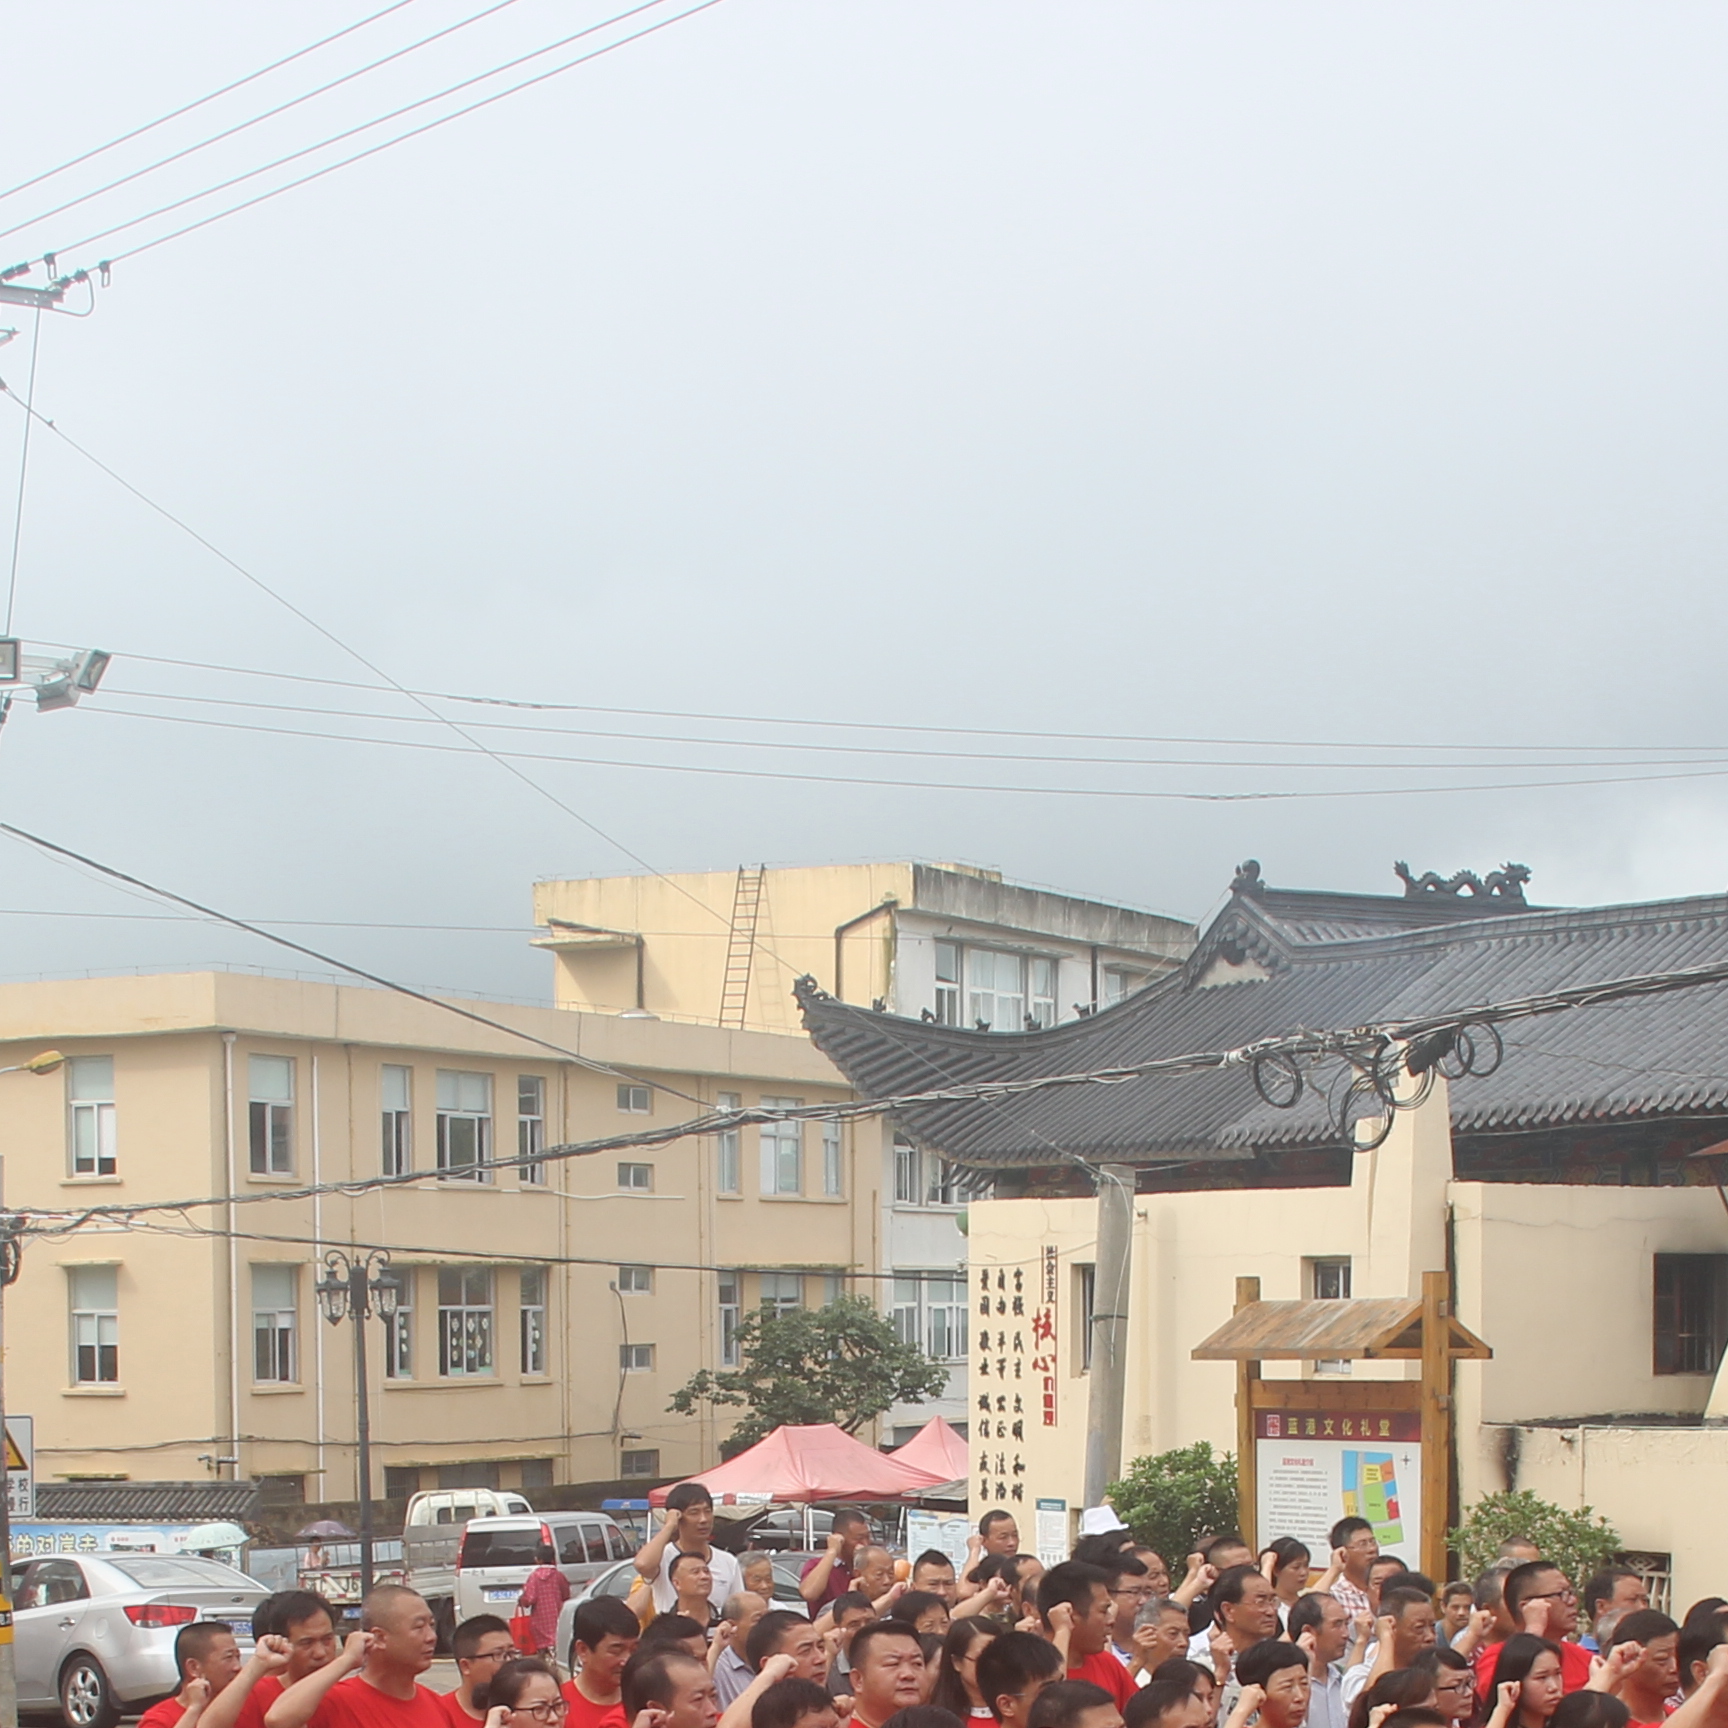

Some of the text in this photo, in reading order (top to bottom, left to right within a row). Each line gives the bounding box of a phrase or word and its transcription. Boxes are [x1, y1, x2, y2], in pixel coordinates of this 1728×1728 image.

[1031, 1307, 1056, 1373] 核心
[1287, 1417, 1391, 1437] 蓝港文化礼堂
[8, 1532, 100, 1553] 的对岸去
